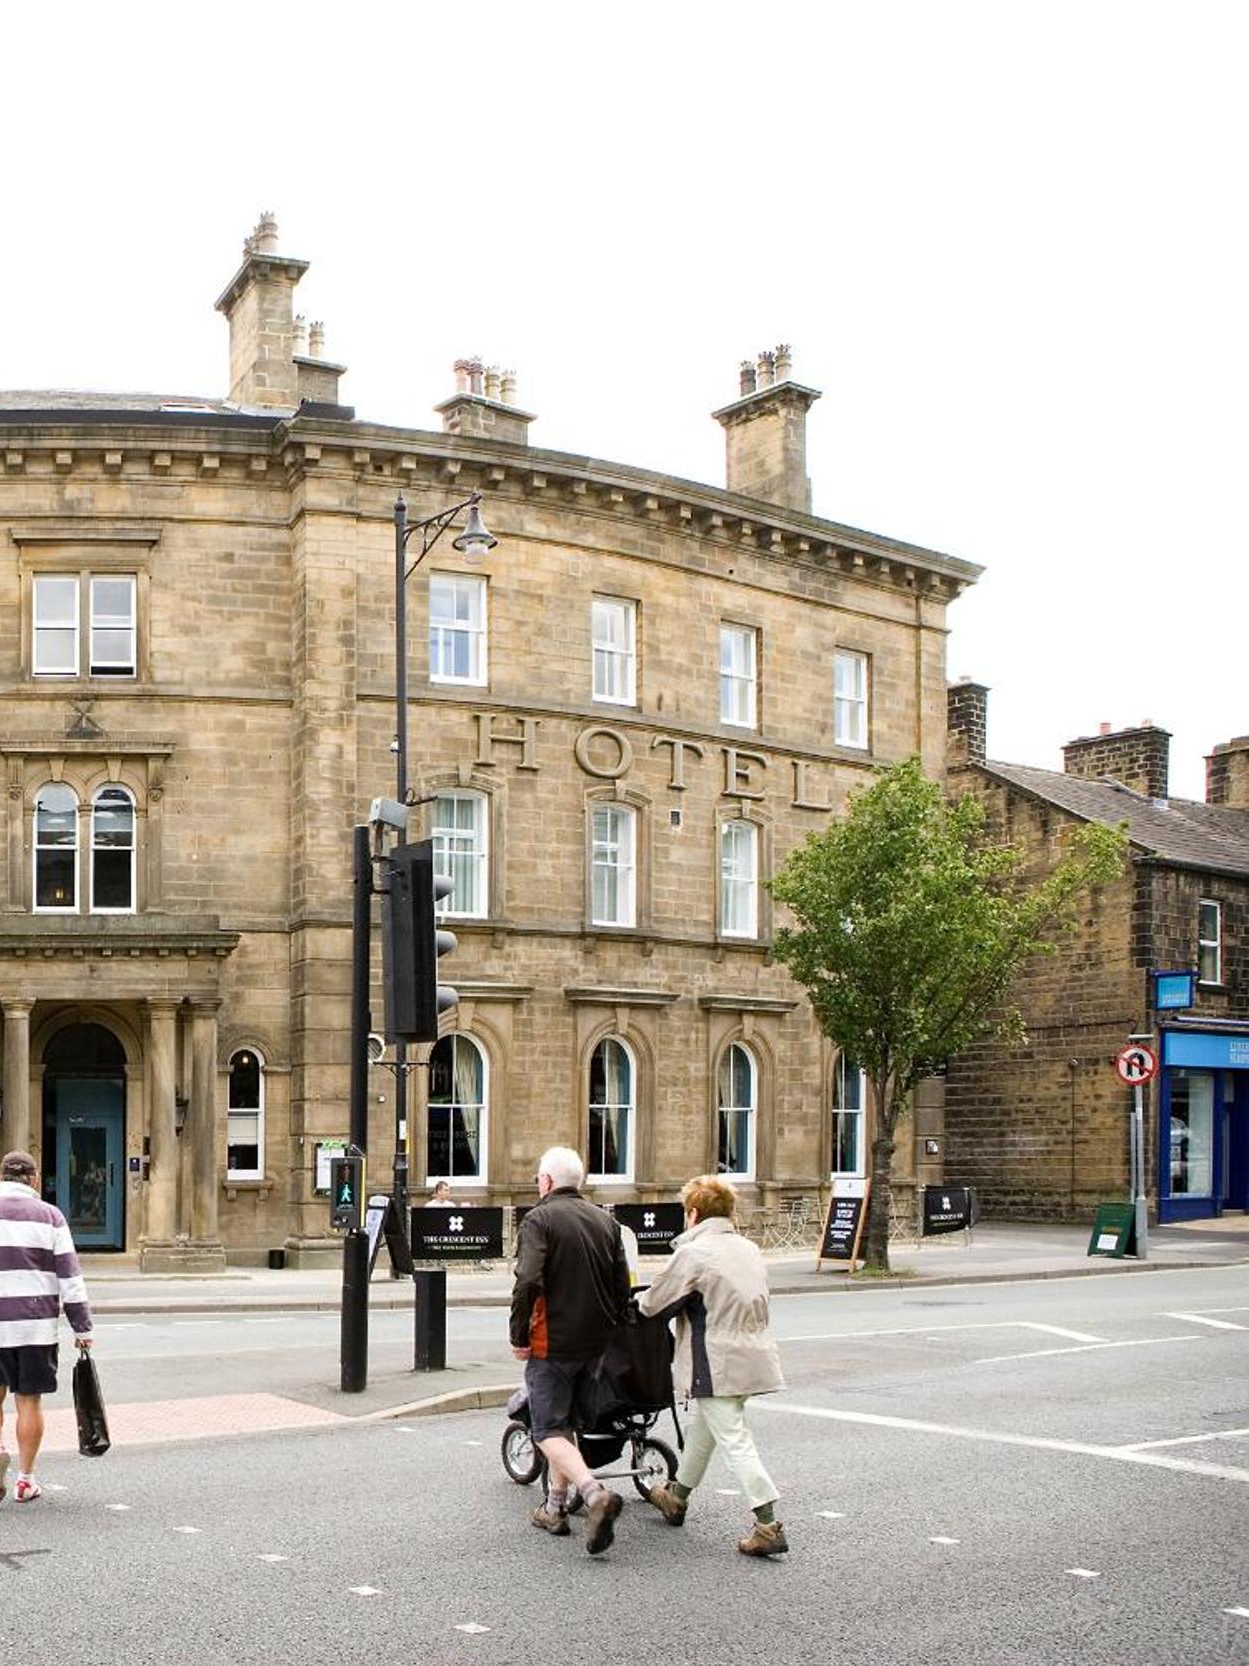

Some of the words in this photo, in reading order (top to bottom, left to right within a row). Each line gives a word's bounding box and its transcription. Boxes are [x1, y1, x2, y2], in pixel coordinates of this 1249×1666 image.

[472, 713, 833, 812] HOTEL
[423, 1235, 438, 1244] THE
[439, 1235, 474, 1244] CRESCENT
[475, 1235, 490, 1244] INN
